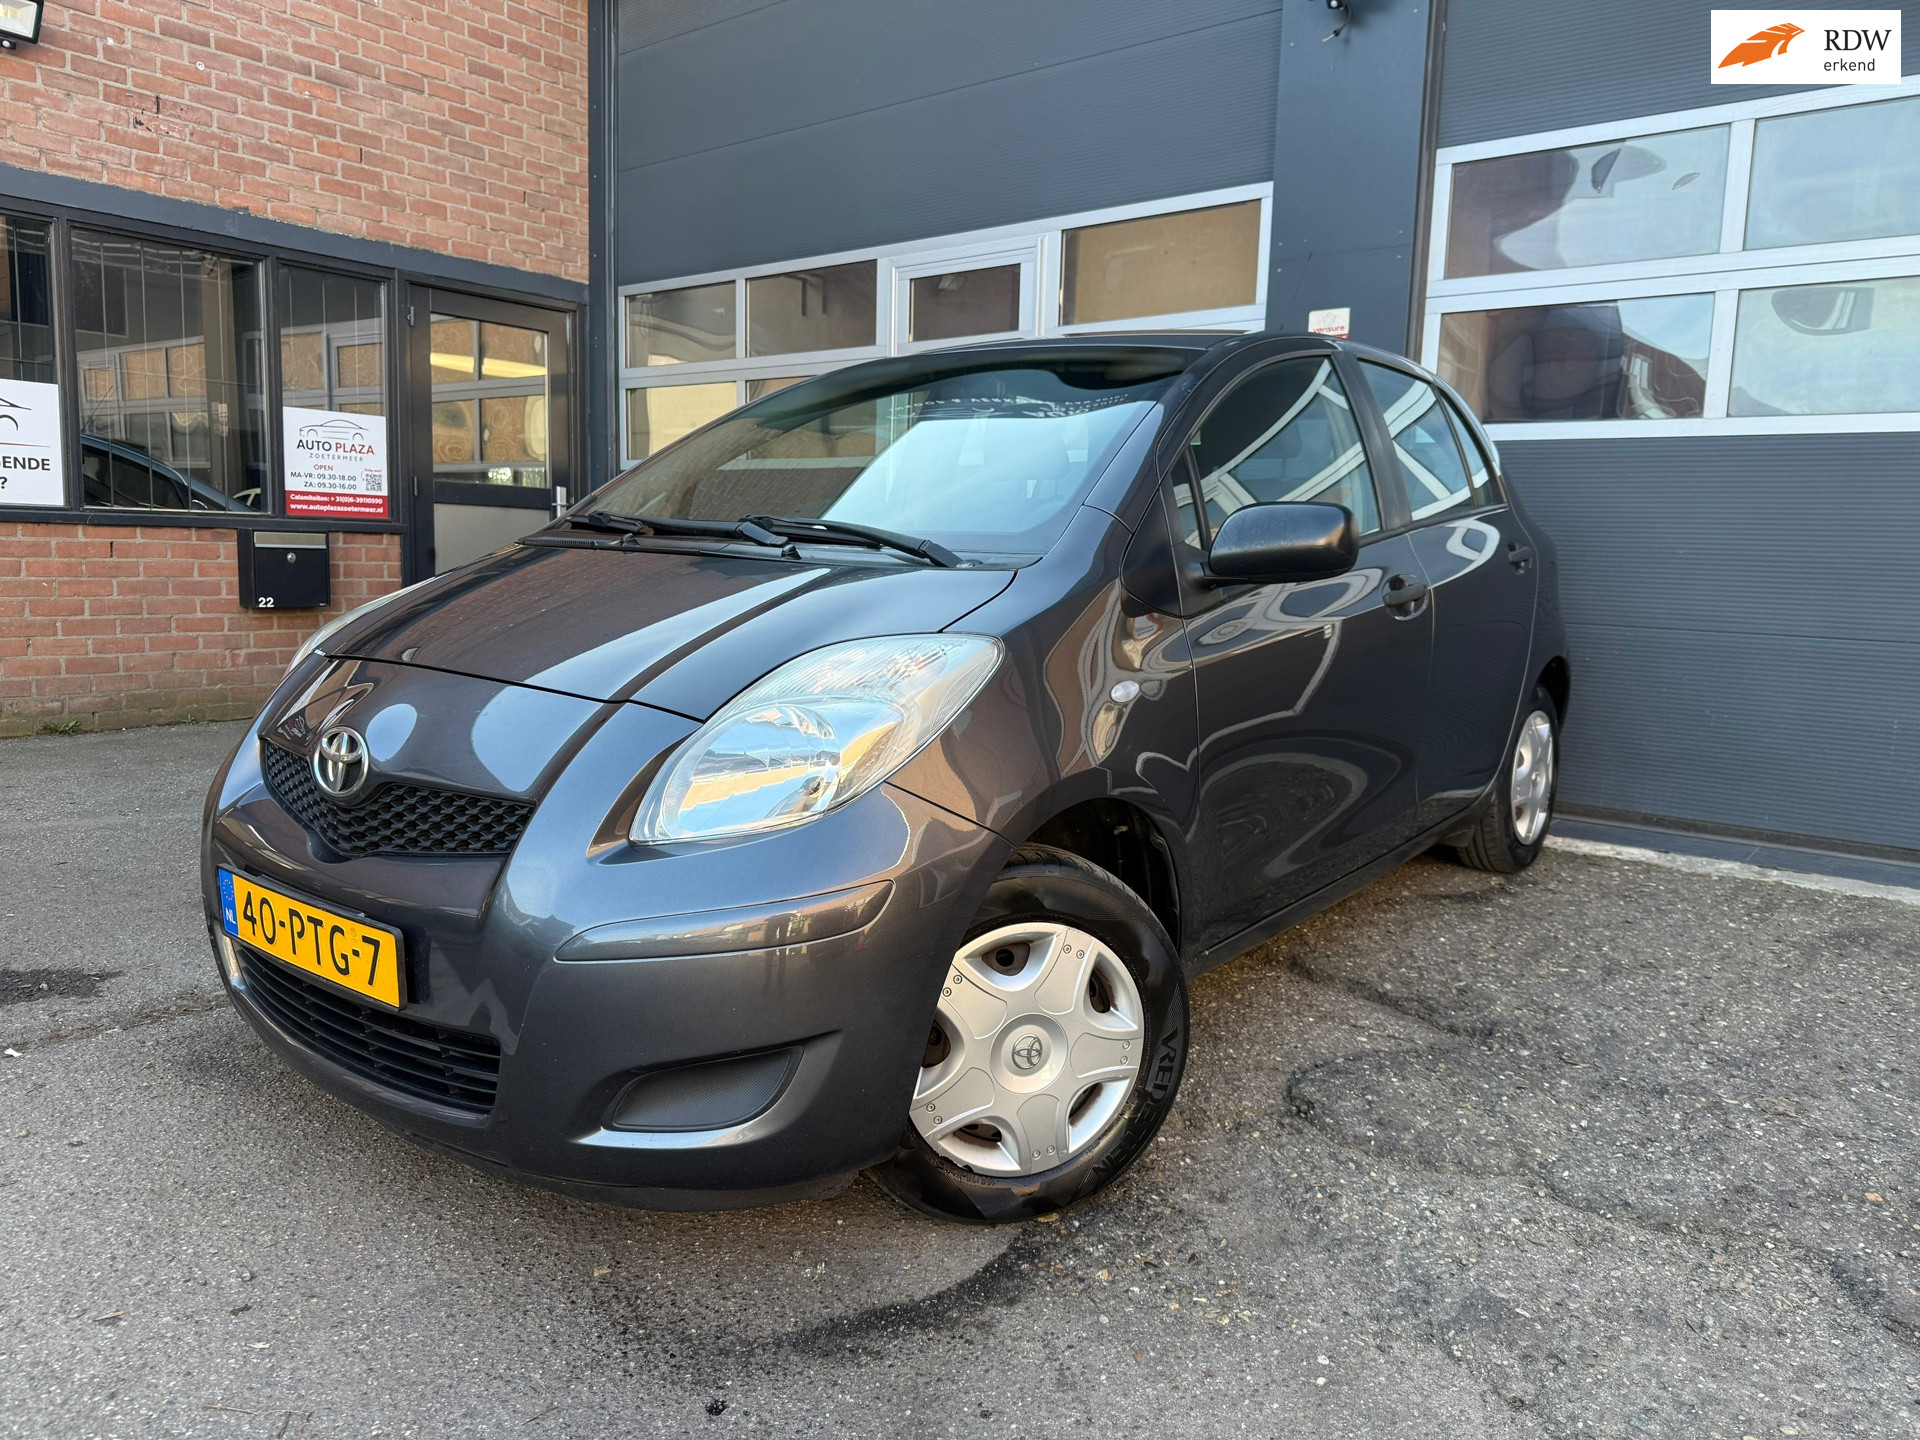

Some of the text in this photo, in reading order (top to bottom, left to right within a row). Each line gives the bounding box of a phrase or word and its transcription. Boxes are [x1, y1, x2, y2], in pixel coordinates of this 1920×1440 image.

[296, 439, 375, 455] AUTO PLAZA
[309, 452, 364, 462] ZOETERMEER
[0, 456, 51, 471] ENDE
[290, 471, 357, 482] MA-VR: 09.30-18.00
[317, 482, 357, 490] 09.30-16.00
[290, 494, 330, 502] Calamiteiten:
[258, 597, 274, 608] 22
[225, 907, 237, 925] NL
[243, 890, 381, 987] 40-PTG-7
